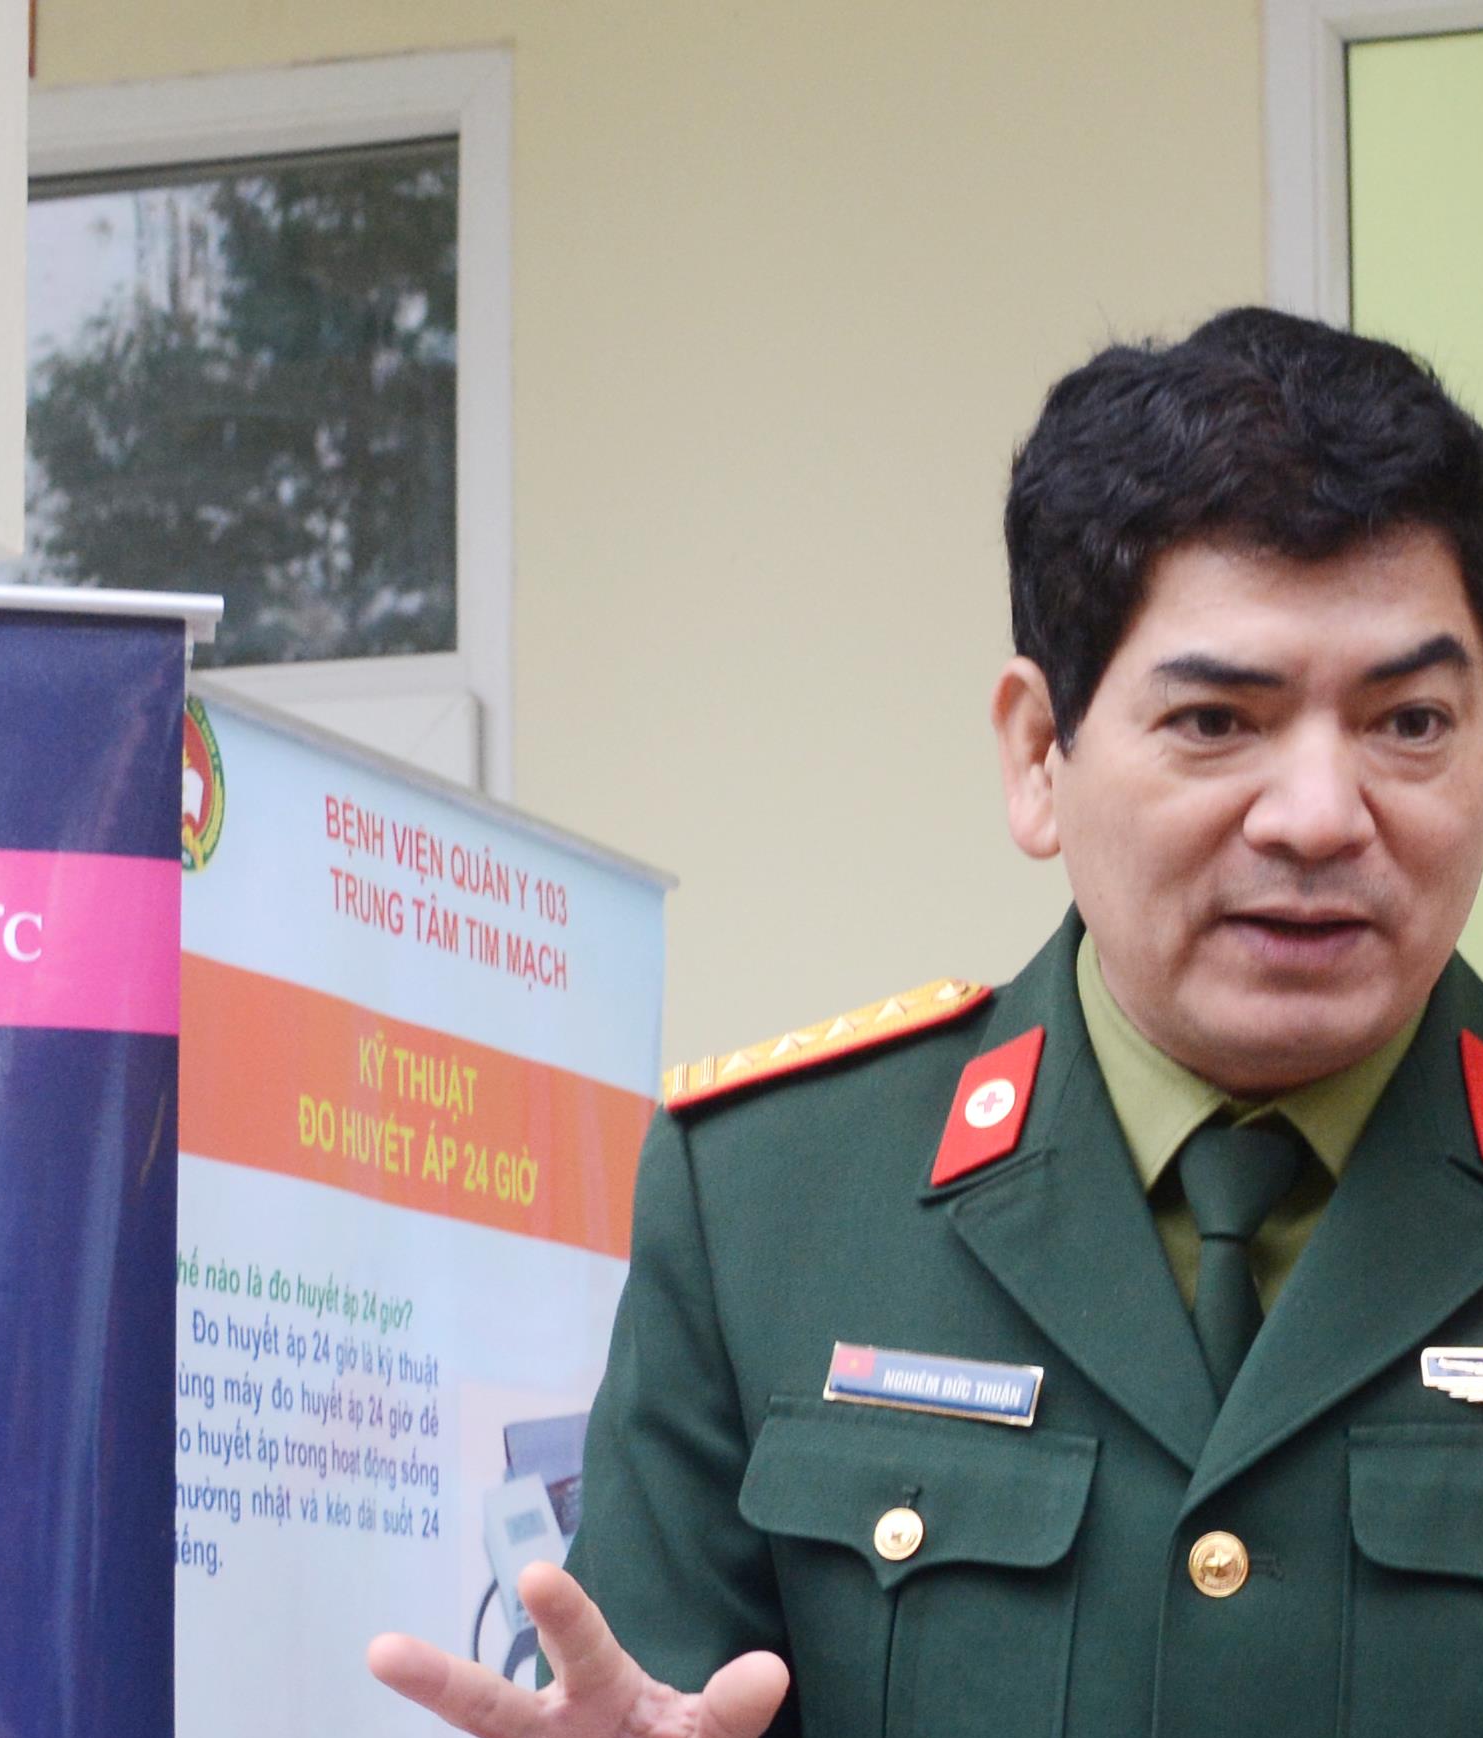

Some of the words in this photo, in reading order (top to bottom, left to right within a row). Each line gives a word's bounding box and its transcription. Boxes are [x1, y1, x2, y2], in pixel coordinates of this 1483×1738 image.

[326, 794, 384, 858] BỆNH
[392, 822, 443, 885] VIỆN
[451, 845, 510, 907] QUÂN
[517, 868, 528, 911] Y
[536, 878, 568, 926] 103
[330, 867, 403, 935] TRUNG
[412, 894, 459, 955] TÂM
[466, 916, 500, 968] TIM
[507, 932, 567, 992] MẠCH
[359, 1030, 386, 1092] KỸ
[393, 1048, 477, 1122] THUẬT
[299, 1094, 335, 1152] ĐO
[343, 1107, 414, 1176] HUYẾT
[422, 1120, 457, 1184] ÁP
[464, 1142, 488, 1194] 24
[495, 1145, 538, 1207] GIỜ
[179, 1362, 215, 1409] ùng
